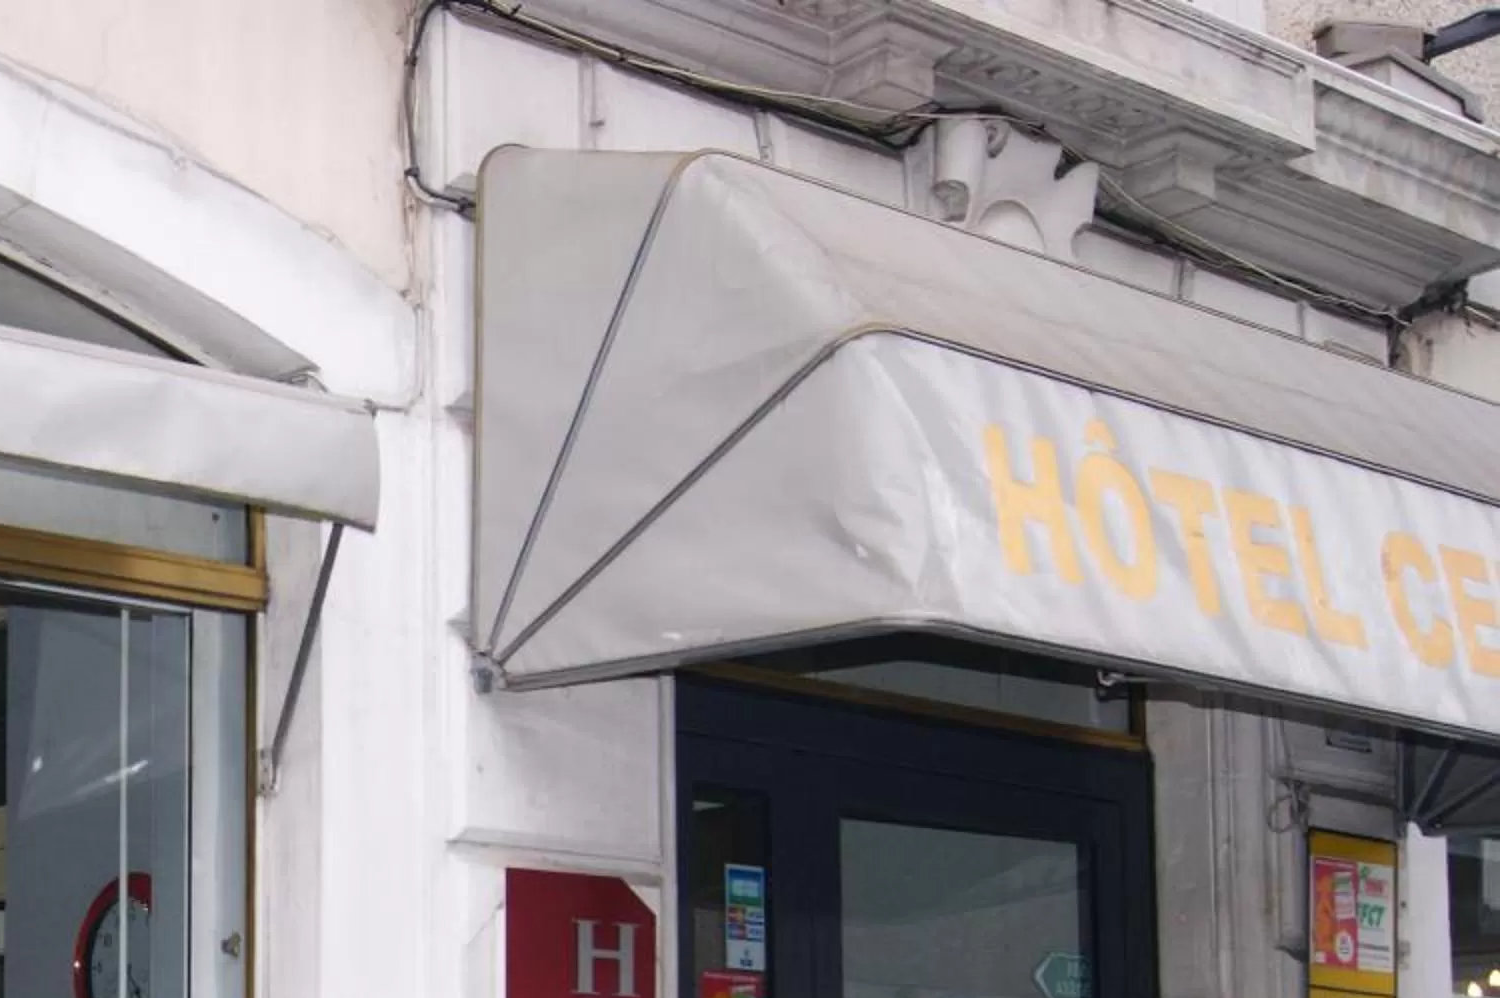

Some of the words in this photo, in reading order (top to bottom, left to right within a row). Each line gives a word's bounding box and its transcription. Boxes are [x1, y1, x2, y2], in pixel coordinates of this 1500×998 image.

[981, 418, 1368, 651] HÔTEL
[1381, 530, 1500, 680] CE
[570, 918, 641, 998] H
